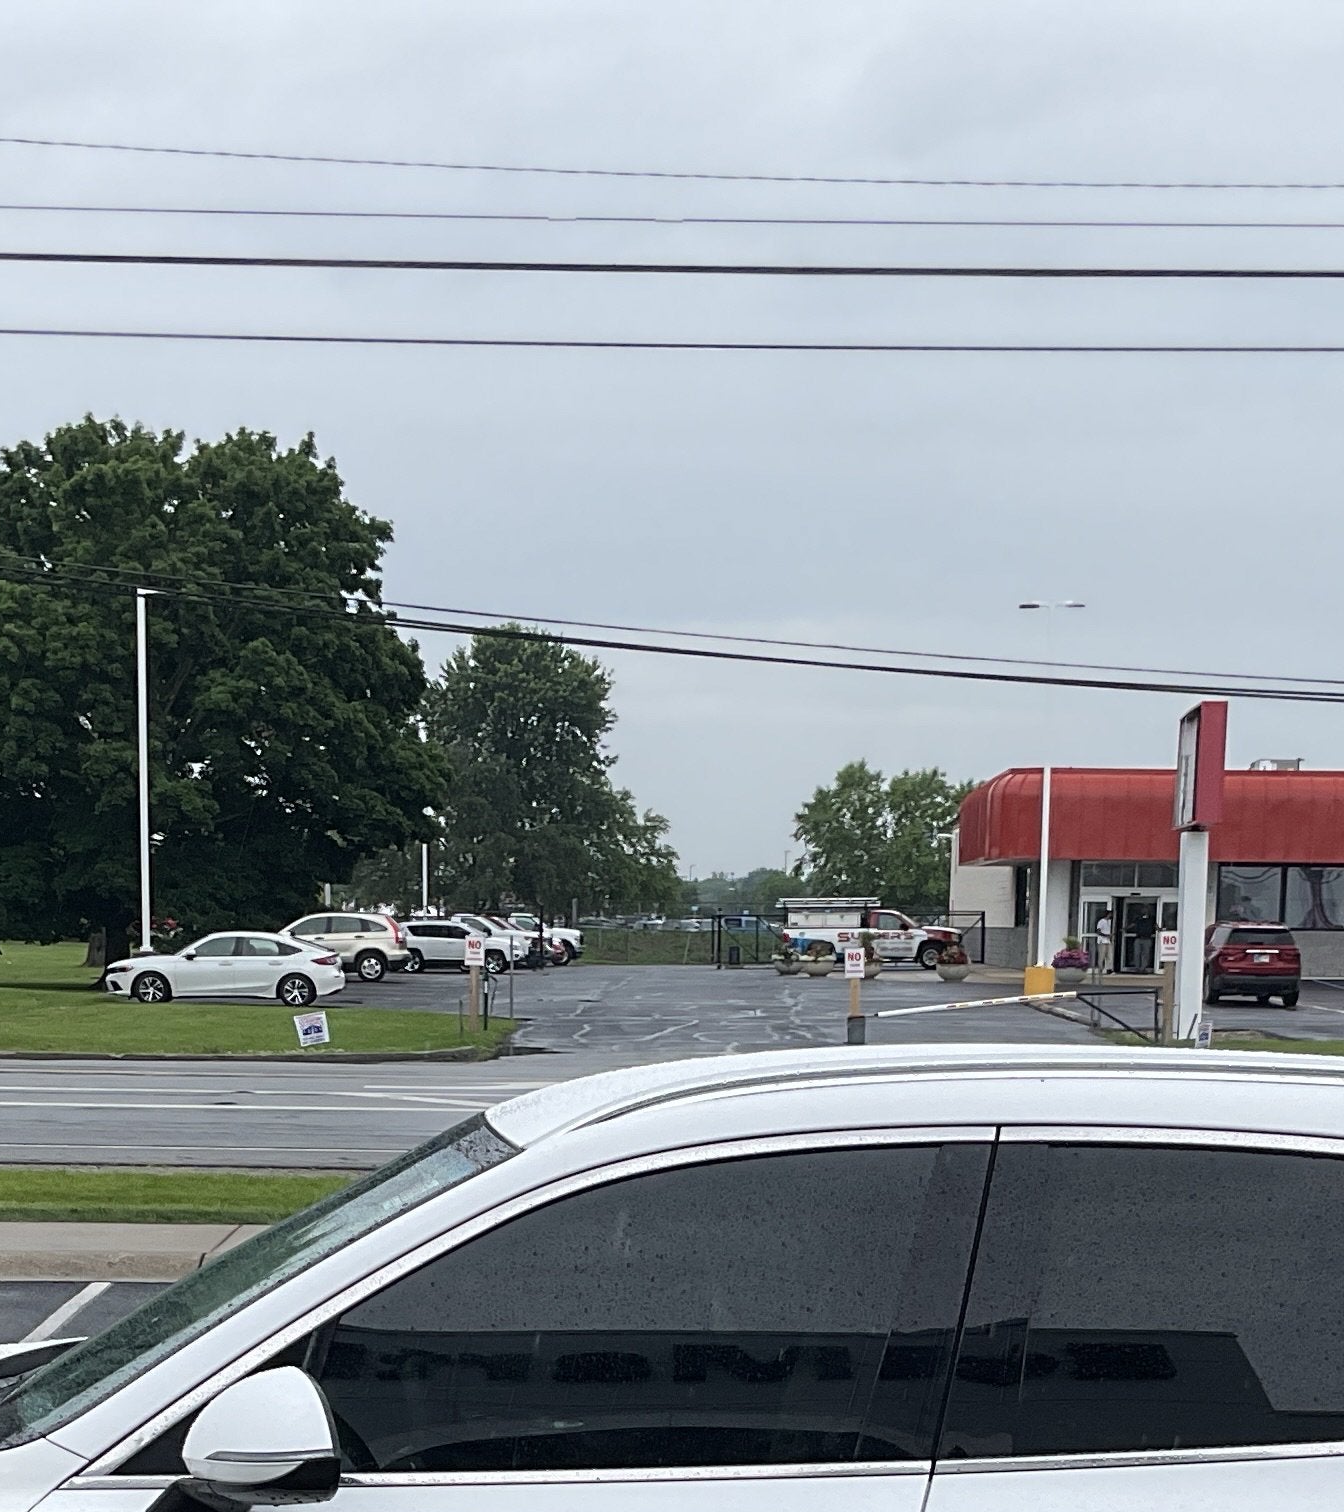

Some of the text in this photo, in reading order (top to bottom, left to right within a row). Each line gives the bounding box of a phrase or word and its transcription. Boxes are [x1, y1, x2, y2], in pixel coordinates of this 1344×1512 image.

[468, 940, 482, 950] NO
[1162, 935, 1177, 945] NO
[847, 952, 862, 962] NO
